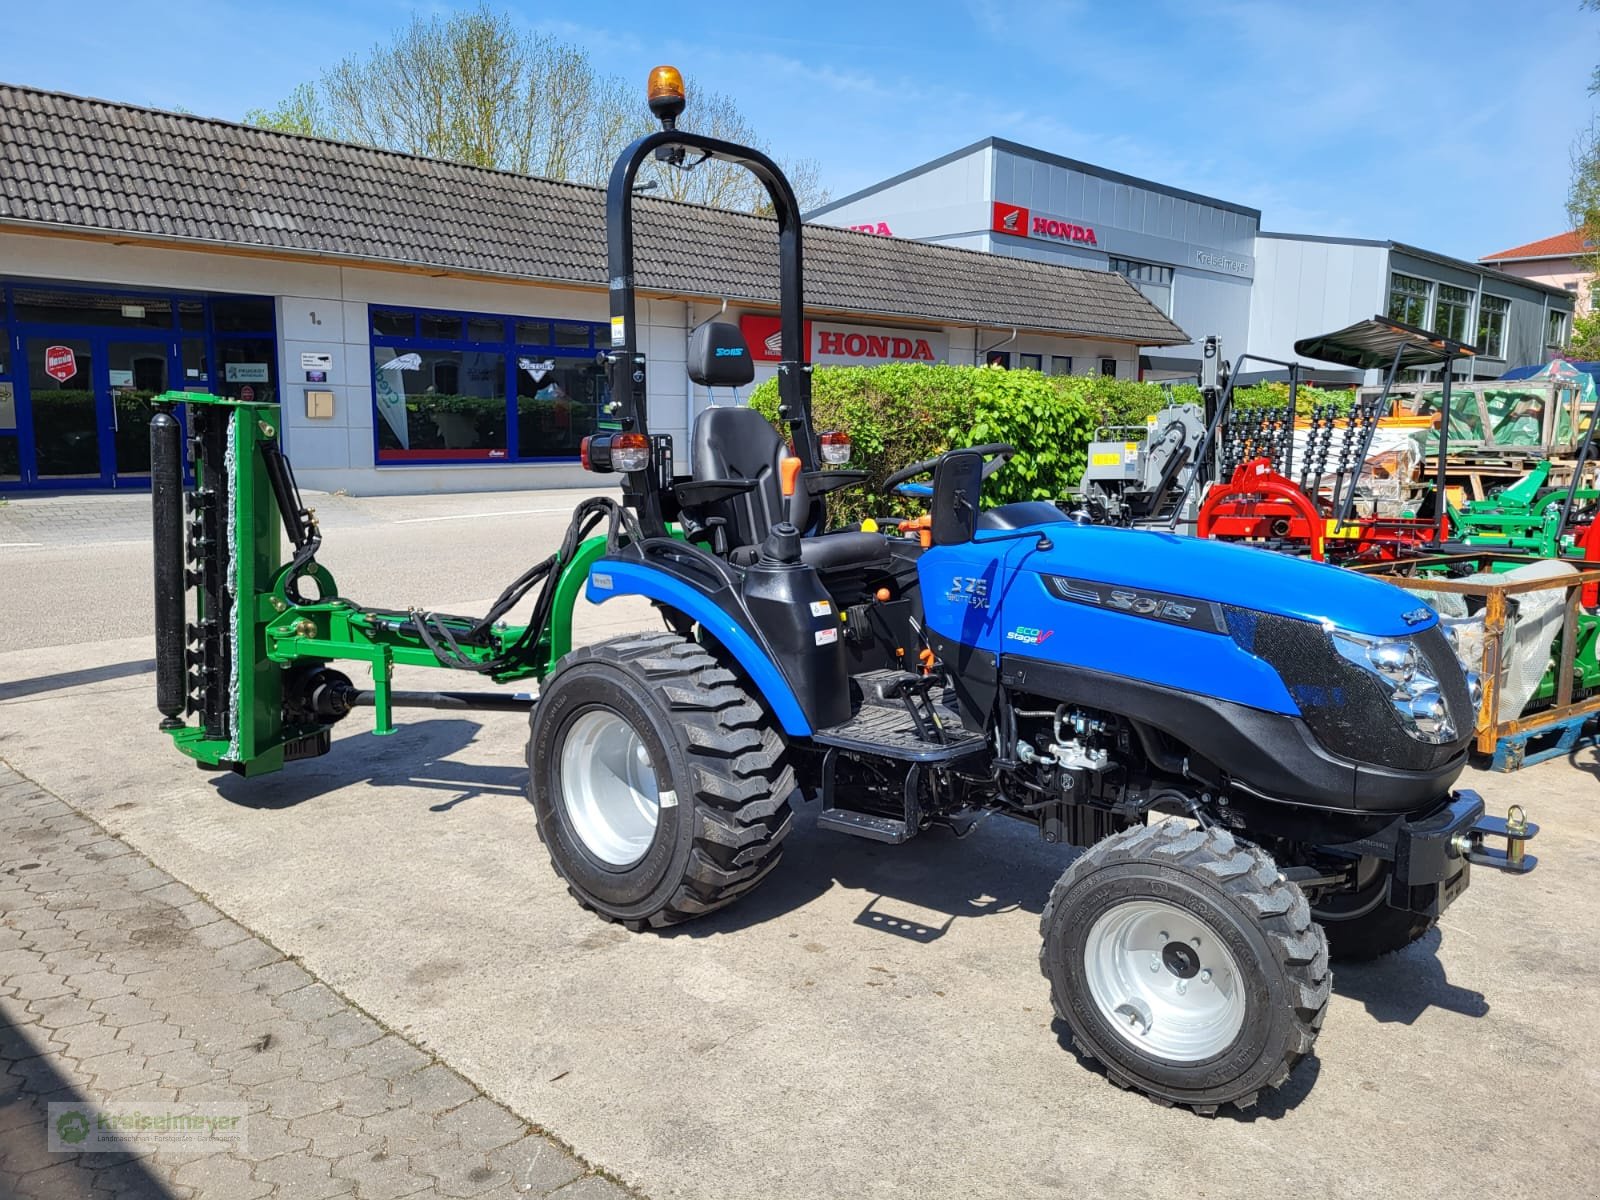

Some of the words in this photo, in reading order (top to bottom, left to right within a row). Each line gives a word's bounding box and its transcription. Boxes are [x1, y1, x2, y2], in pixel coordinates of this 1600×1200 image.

[1033, 217, 1097, 244] HONDA
[1196, 250, 1249, 272] Kreiselmeyer
[818, 332, 935, 361] HONDA
[951, 576, 963, 592] S
[1007, 631, 1038, 644] stage
